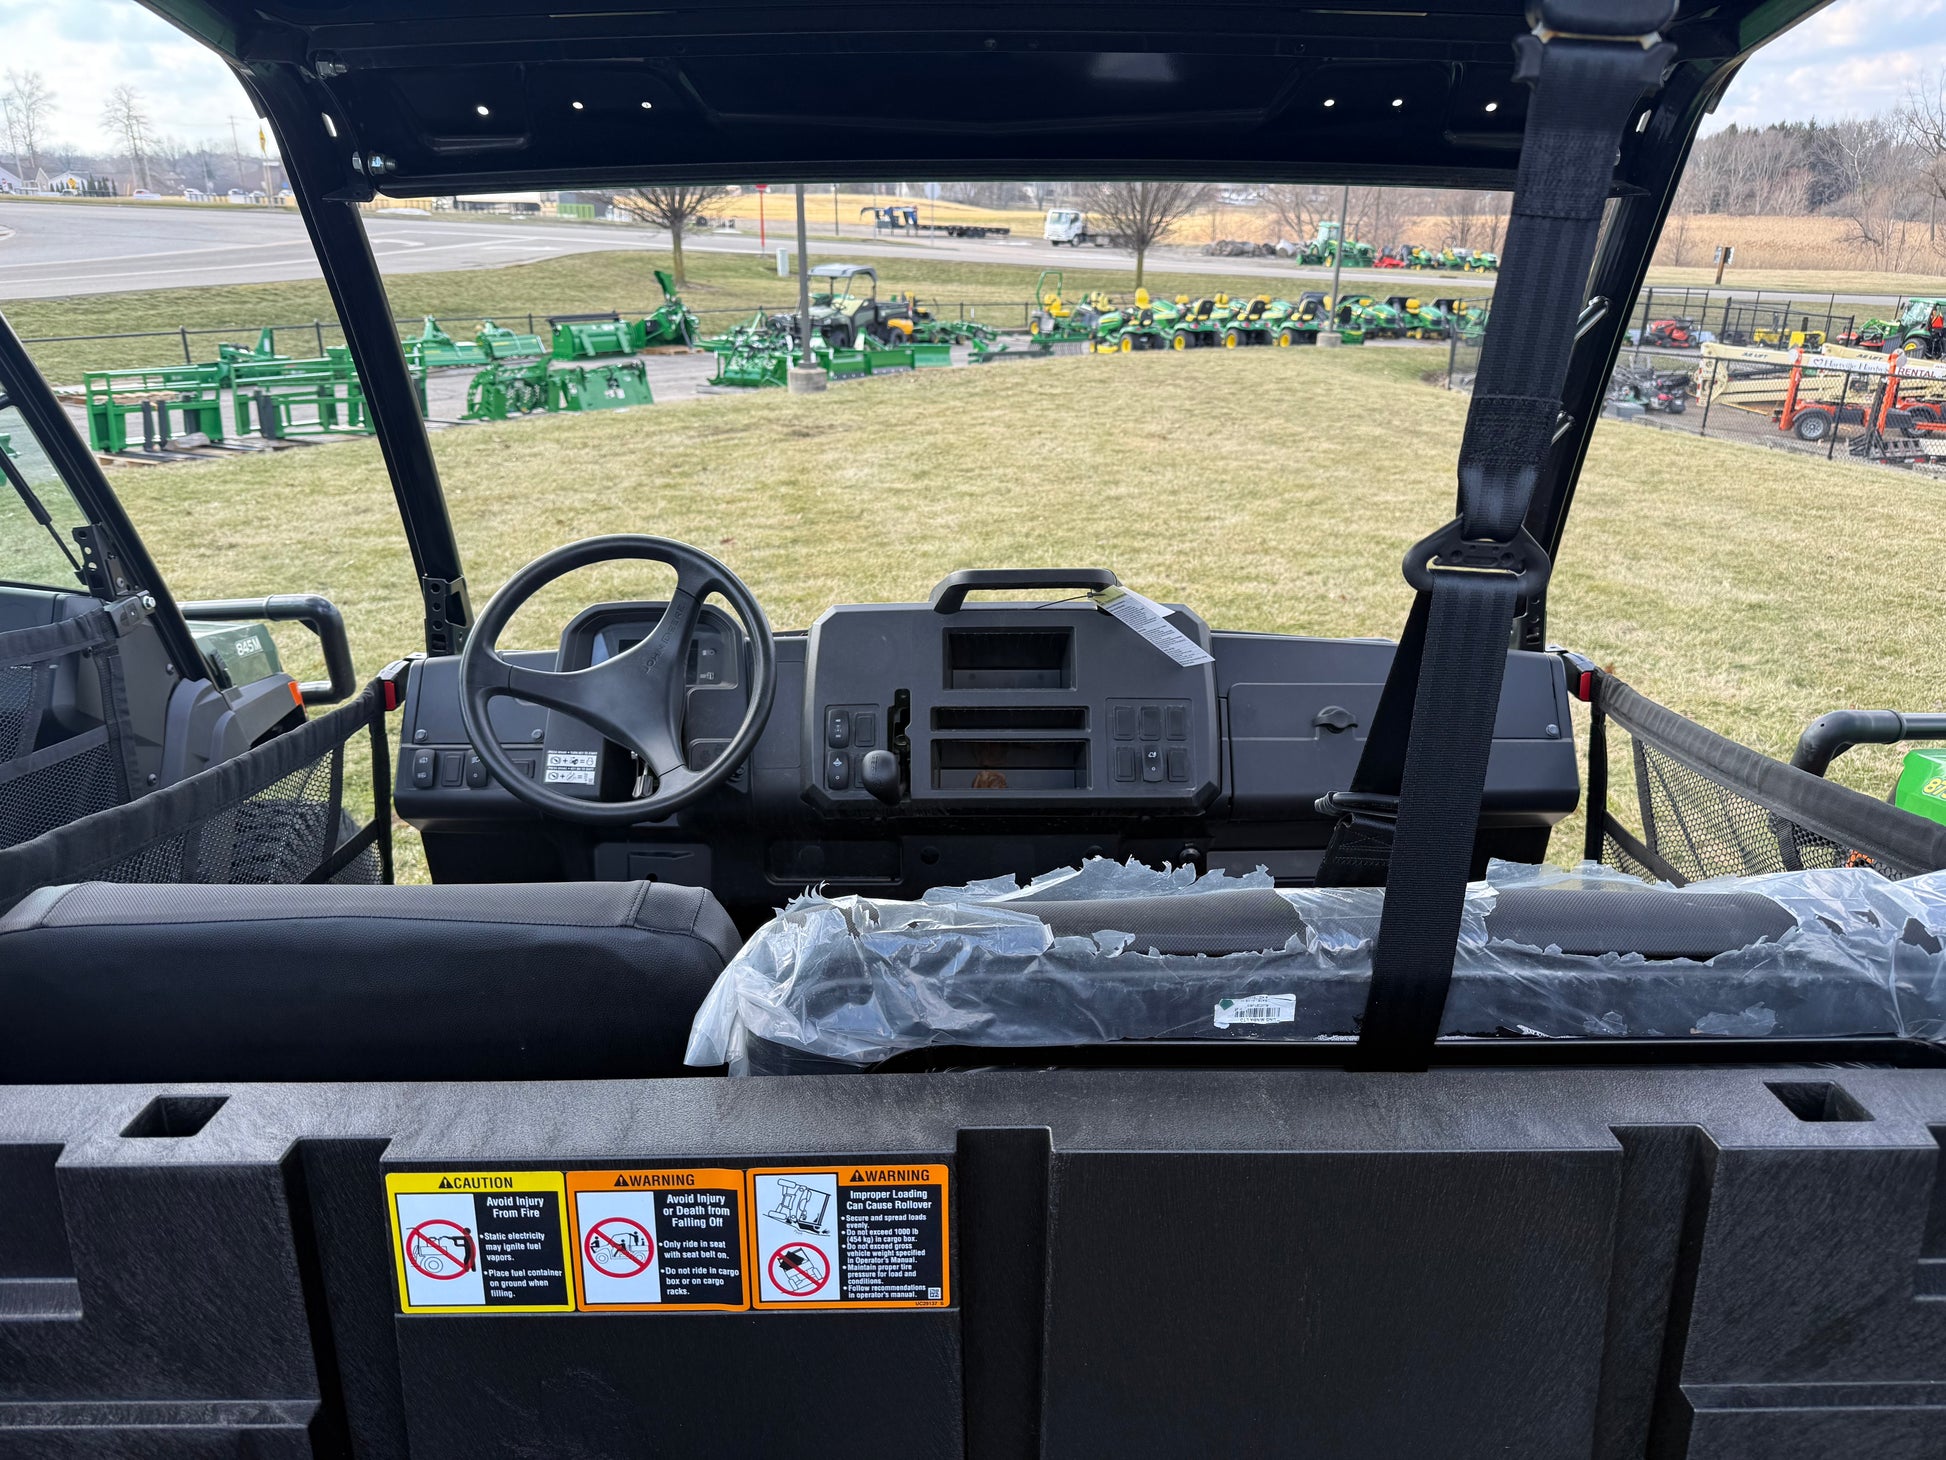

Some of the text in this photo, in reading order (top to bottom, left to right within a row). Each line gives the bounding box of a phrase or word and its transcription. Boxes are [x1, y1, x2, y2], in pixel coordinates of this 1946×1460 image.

[1898, 367, 1936, 378] RENTAL
[235, 637, 262, 655] 845M
[629, 1174, 695, 1186] WARNING
[865, 1170, 929, 1182] WARNING
[453, 1176, 513, 1189] CAUTION
[666, 1194, 725, 1205] Avoid Injury
[850, 1190, 927, 1200] Improper Loading
[486, 1197, 544, 1208] Avoid Injury
[847, 1201, 932, 1210] Can Cause Rollover
[493, 1208, 540, 1218] From Fire
[663, 1206, 730, 1216] or Death from
[672, 1218, 723, 1228] Falling Off
[884, 1215, 906, 1223] spread
[508, 1232, 545, 1241] electricity
[862, 1236, 874, 1244] kg)
[486, 1242, 541, 1252] may ignite fuel
[664, 1241, 681, 1249] Only
[664, 1251, 680, 1259] with
[896, 1249, 925, 1257] specified
[486, 1254, 515, 1262] vapors.
[856, 1257, 888, 1265] Operator's
[511, 1269, 526, 1277] fuel
[528, 1269, 562, 1277] container
[848, 1271, 876, 1279] pressure
[501, 1280, 527, 1288] ground
[703, 1278, 724, 1286] cargo
[491, 1290, 515, 1298] filling.
[856, 1291, 891, 1299] operator's
